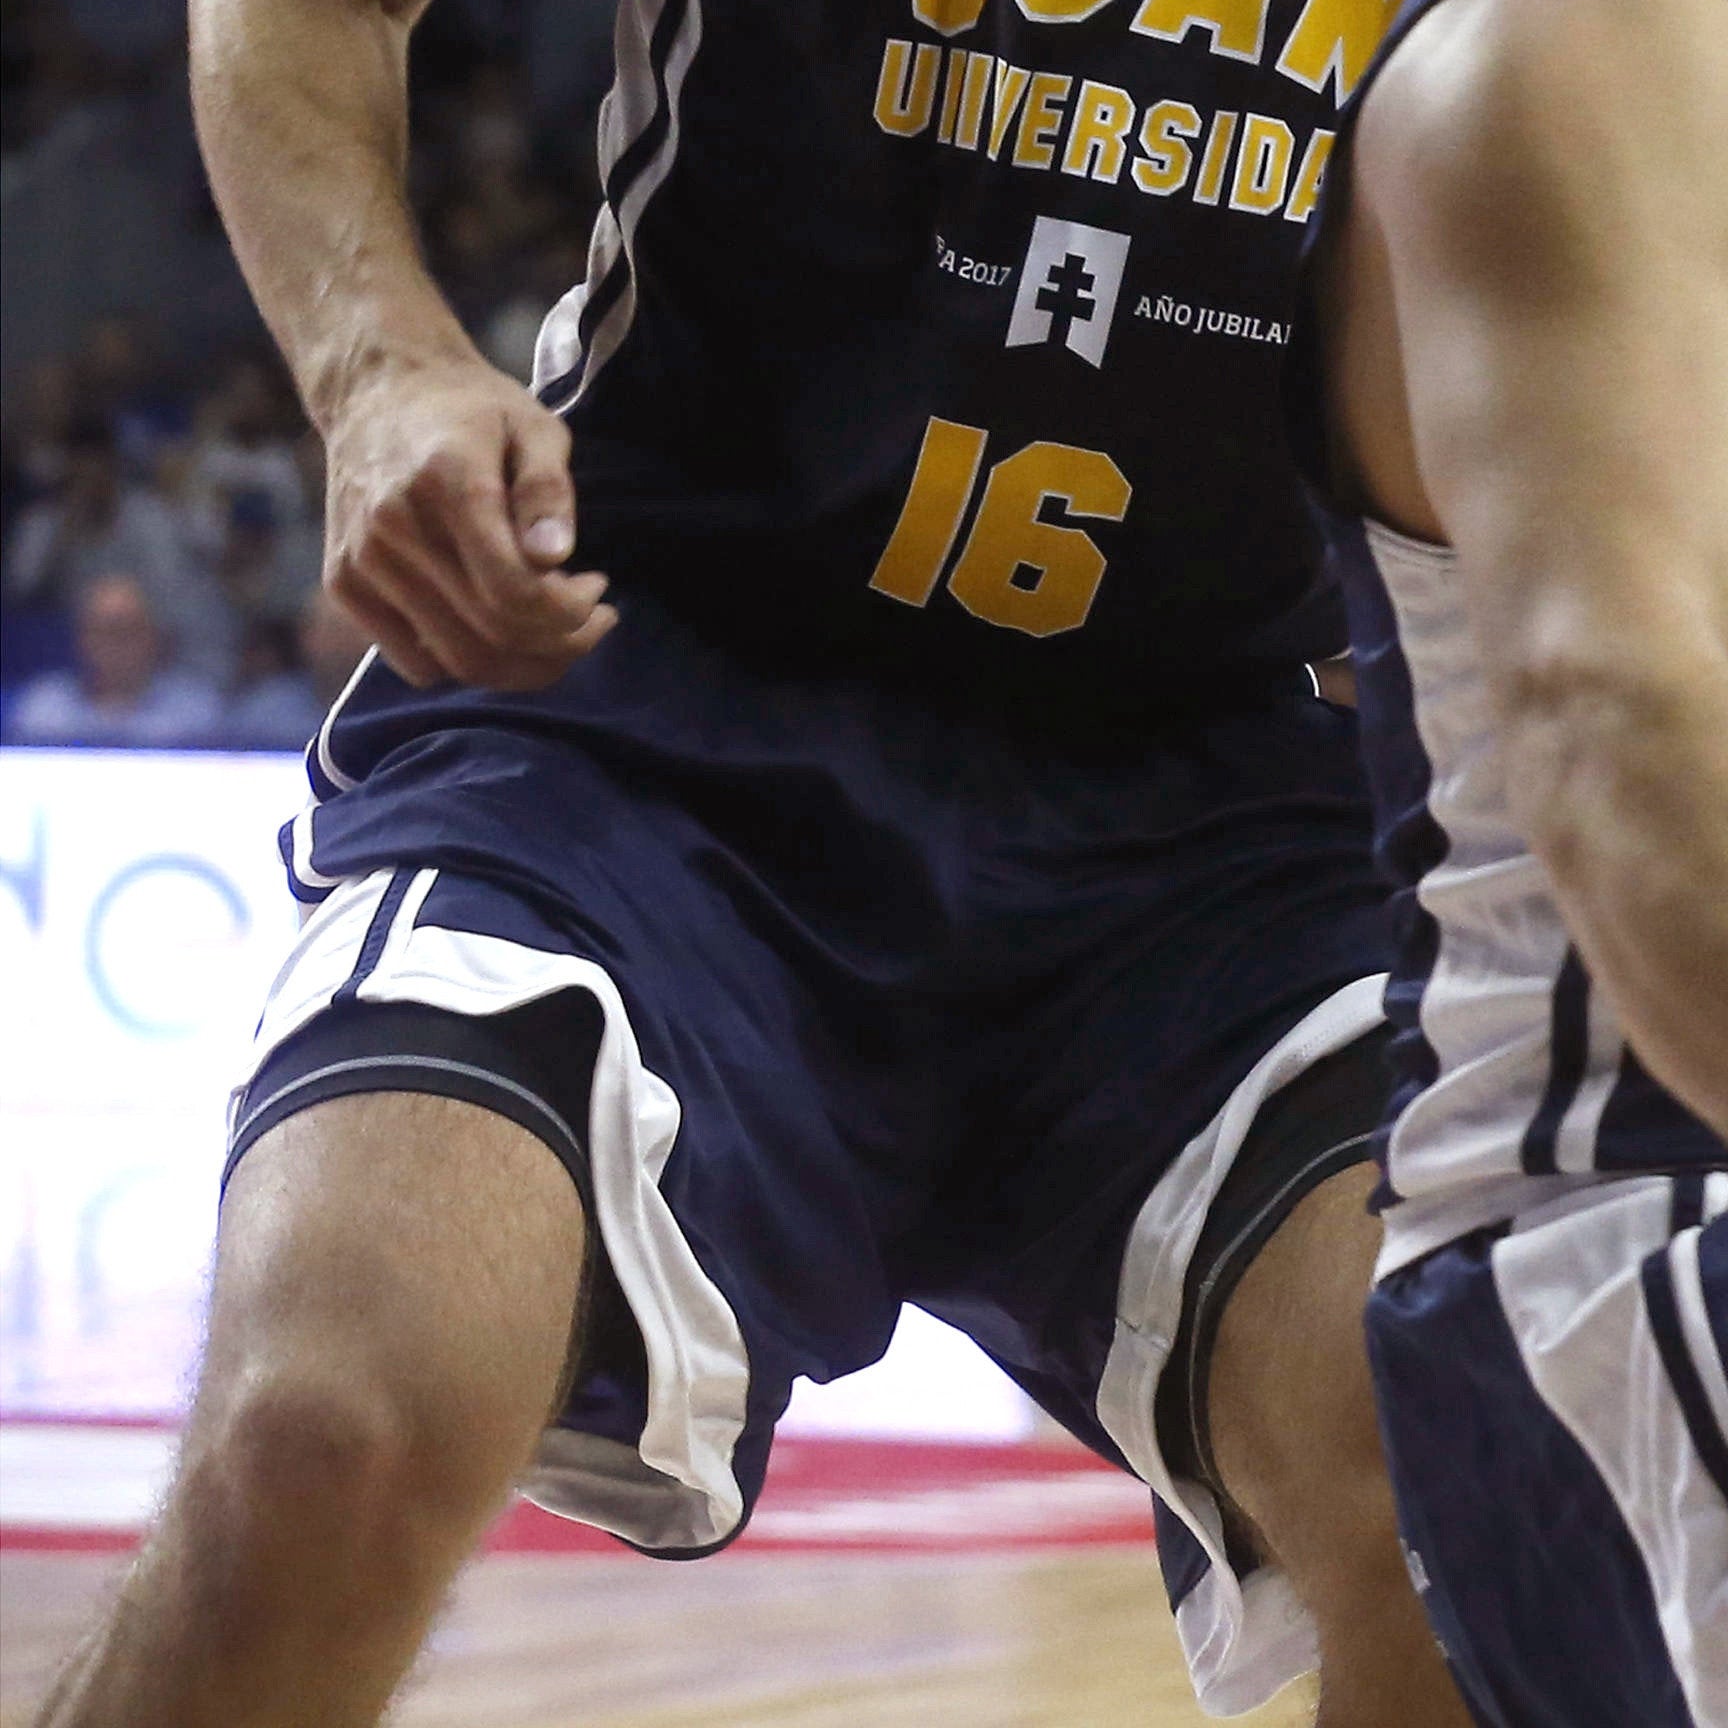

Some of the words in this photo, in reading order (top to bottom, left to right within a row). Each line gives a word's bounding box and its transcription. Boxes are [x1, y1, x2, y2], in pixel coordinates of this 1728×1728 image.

[873, 38, 1337, 223] UNIVERSIDA
[958, 255, 1012, 287] 2017
[1133, 295, 1192, 327] AÑO
[1193, 307, 1293, 346] JUBILA
[866, 415, 1134, 638] 16
